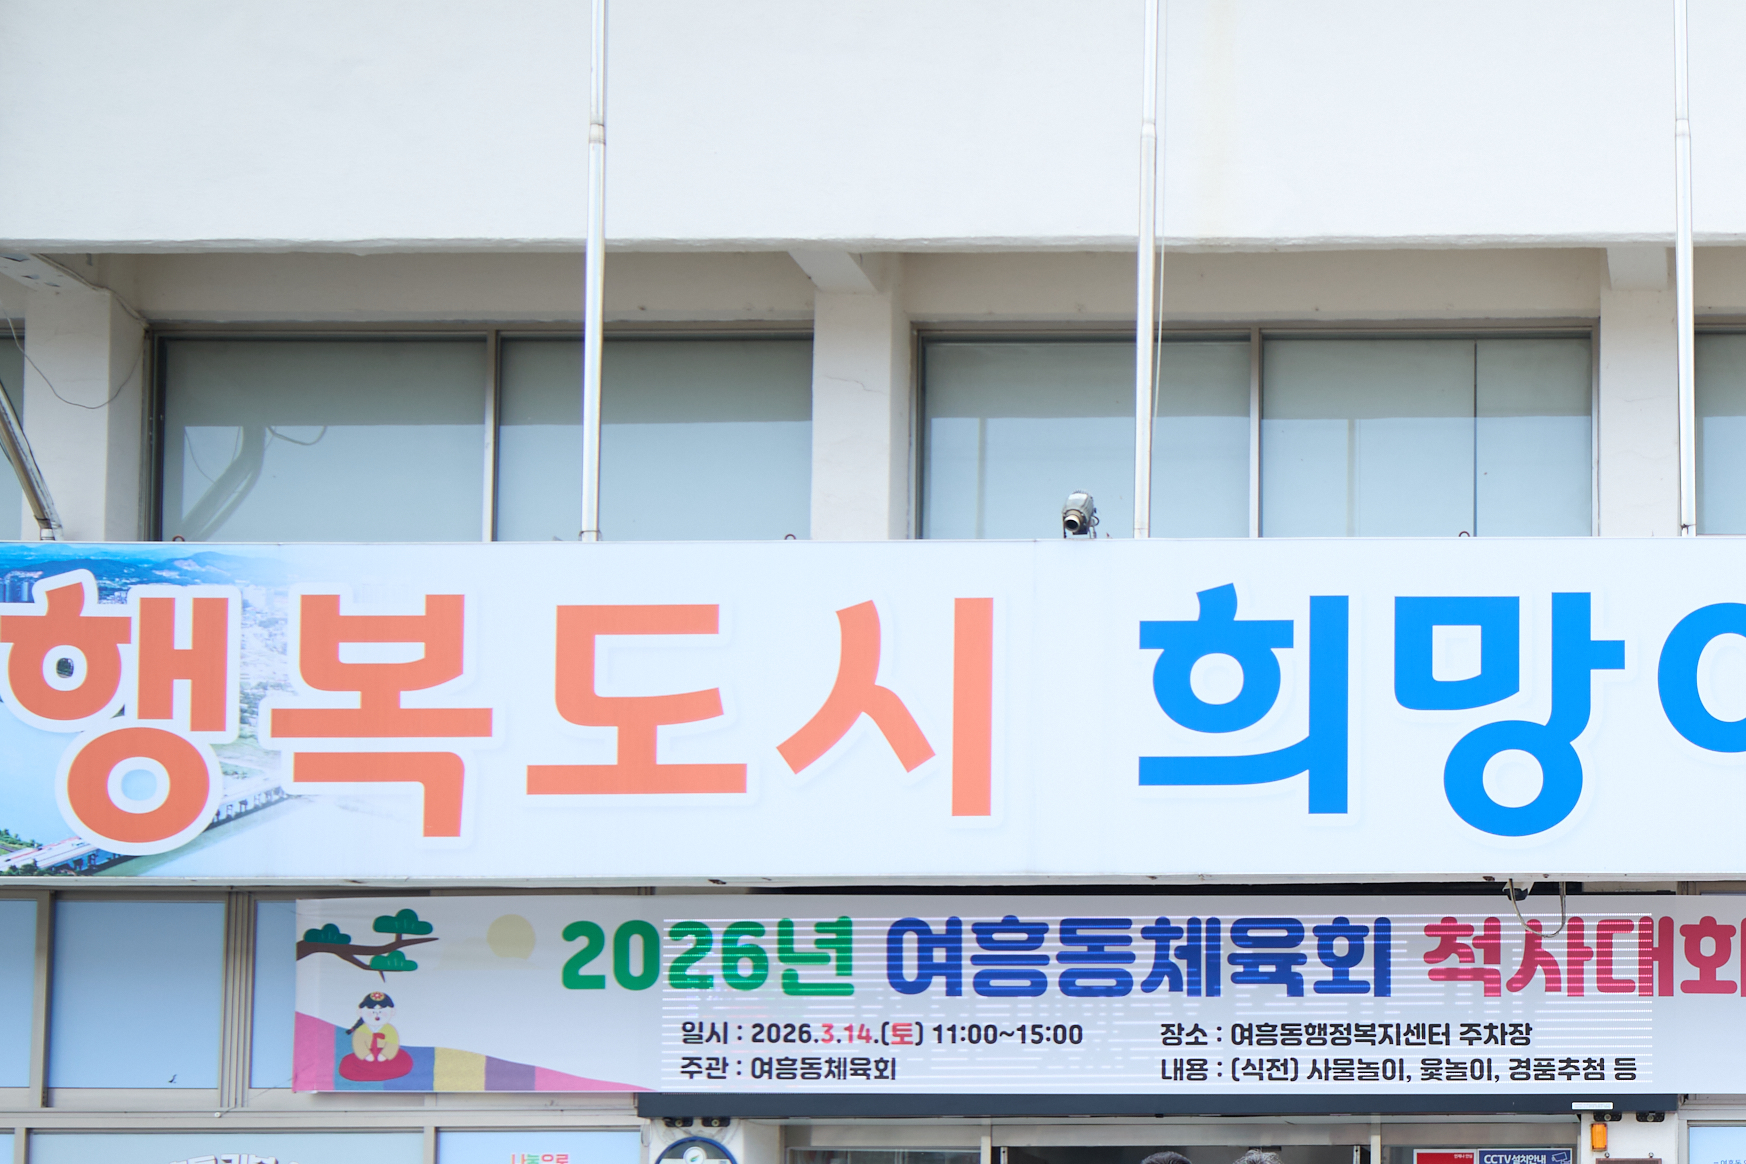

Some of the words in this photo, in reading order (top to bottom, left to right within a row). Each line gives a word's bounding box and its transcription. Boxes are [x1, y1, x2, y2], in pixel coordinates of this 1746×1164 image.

[0, 581, 994, 843] 행복도시
[561, 915, 855, 997] 2026년
[886, 914, 1391, 998] 여흥동체육회
[681, 1021, 729, 1045] 일시
[750, 1021, 924, 1046] 2026.3.14.(토)
[932, 1023, 1083, 1045] 11:00~15:00
[1160, 1022, 1209, 1047] 장소
[1230, 1022, 1452, 1047] 여흥동행정복지센터
[1458, 1022, 1533, 1047] 주차장
[680, 1056, 729, 1081] 주관
[750, 1056, 897, 1081] 여흥동체육회
[1160, 1057, 1209, 1082] 내용
[1230, 1057, 1299, 1083] (식전)
[1307, 1057, 1412, 1083] 사물놀이,
[1419, 1057, 1500, 1083] 윷놀이,
[1508, 1057, 1606, 1082] 경품추첨
[1613, 1057, 1638, 1082] 등
